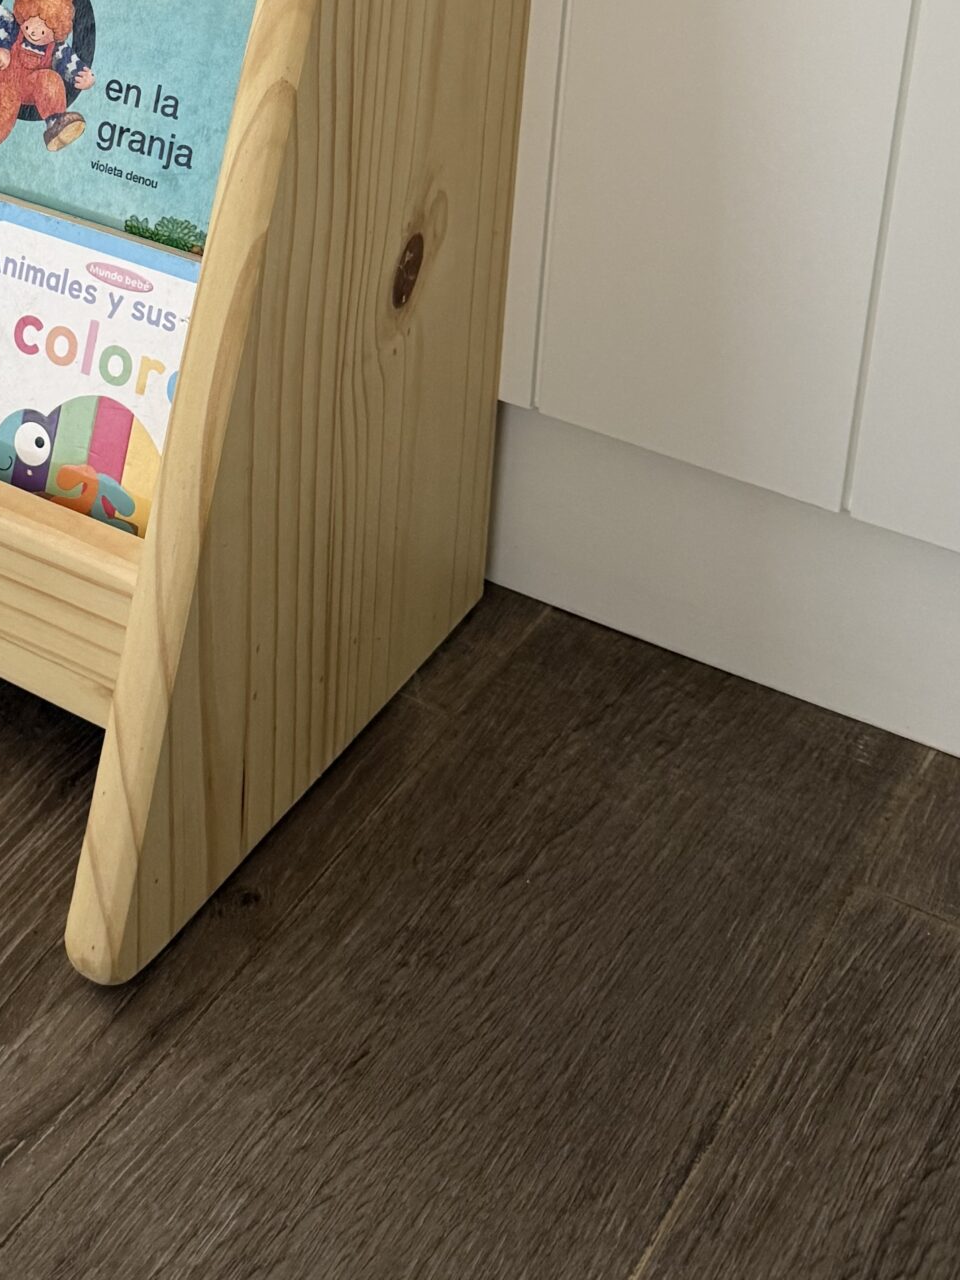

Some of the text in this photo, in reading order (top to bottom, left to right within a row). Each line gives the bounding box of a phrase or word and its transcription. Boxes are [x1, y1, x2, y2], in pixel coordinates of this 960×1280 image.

[105, 79, 179, 120] en la
[96, 121, 193, 170] granja
[90, 160, 158, 189] violeta denou
[89, 264, 151, 291] Mundo bebé
[107, 292, 124, 319] y
[131, 300, 177, 332] sus
